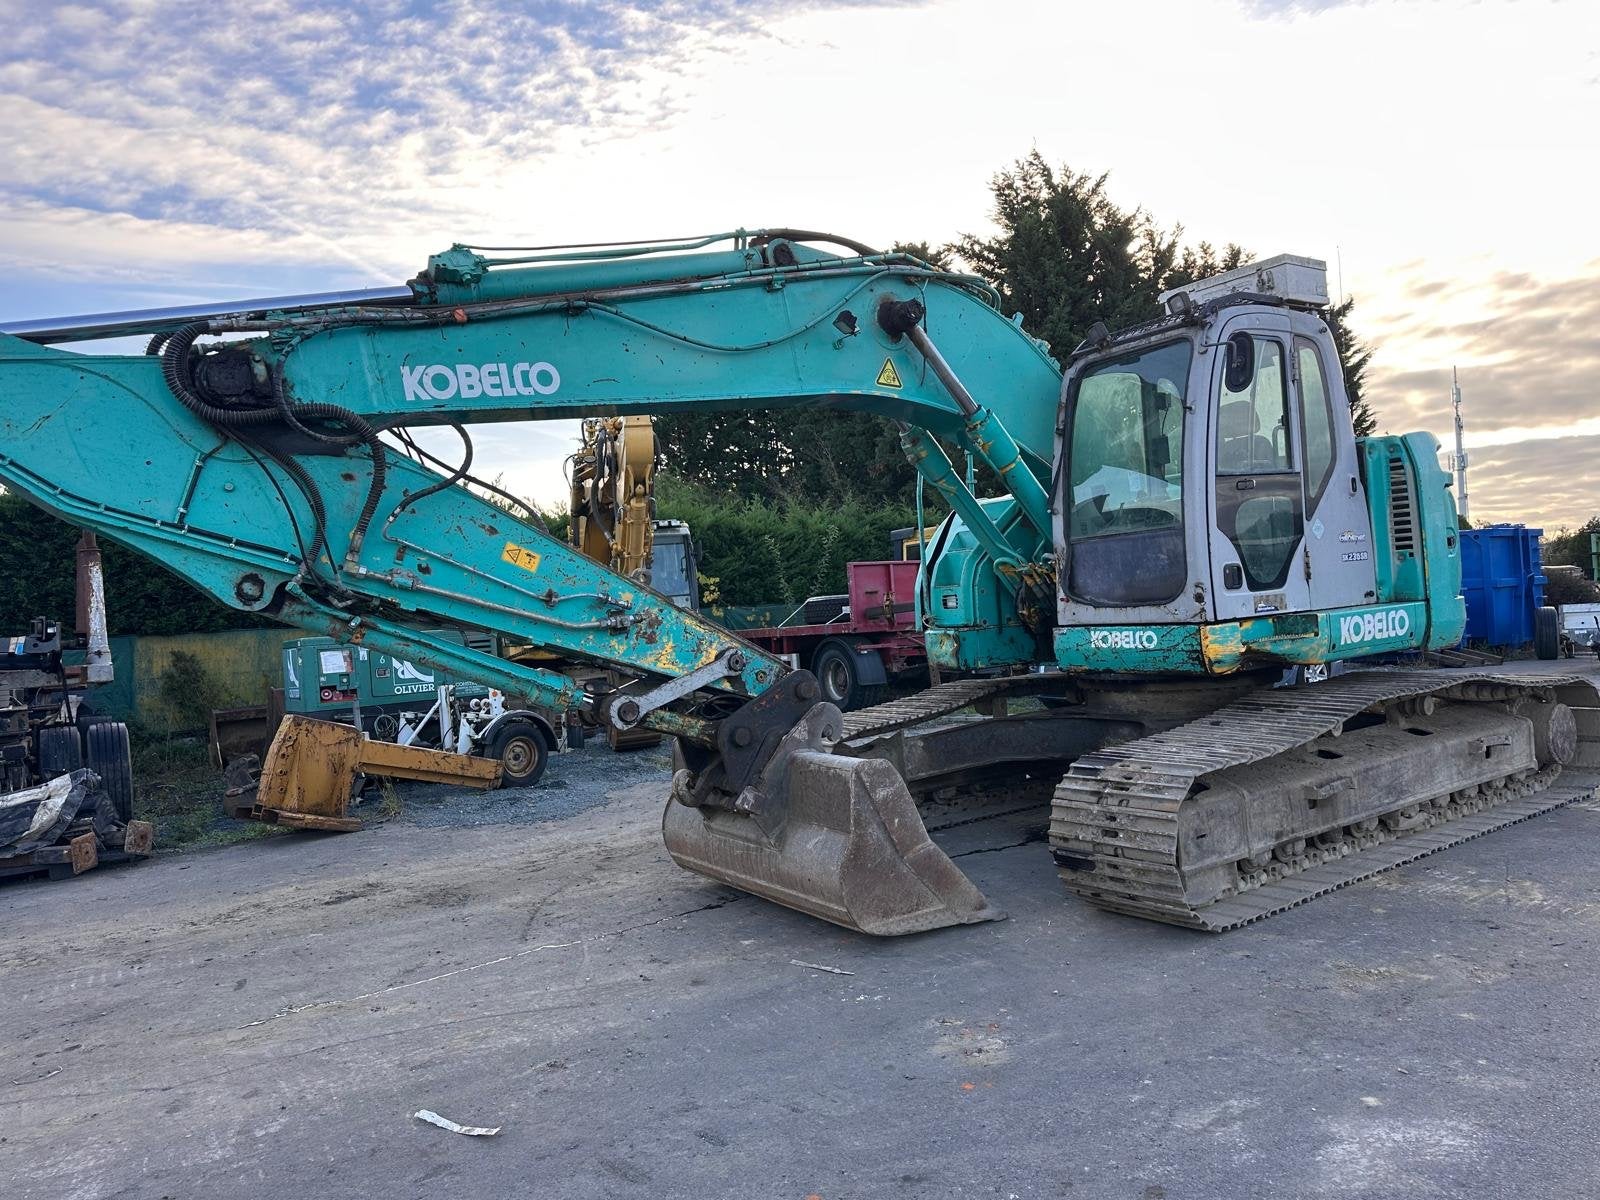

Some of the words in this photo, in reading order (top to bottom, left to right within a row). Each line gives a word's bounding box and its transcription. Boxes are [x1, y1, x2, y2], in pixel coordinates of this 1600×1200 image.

[400, 362, 561, 401] KOBELCO
[1340, 609, 1410, 645] KOBELCO
[1090, 630, 1158, 648] KOBELCO
[379, 655, 386, 664] 6
[394, 683, 435, 695] OLIVIER
